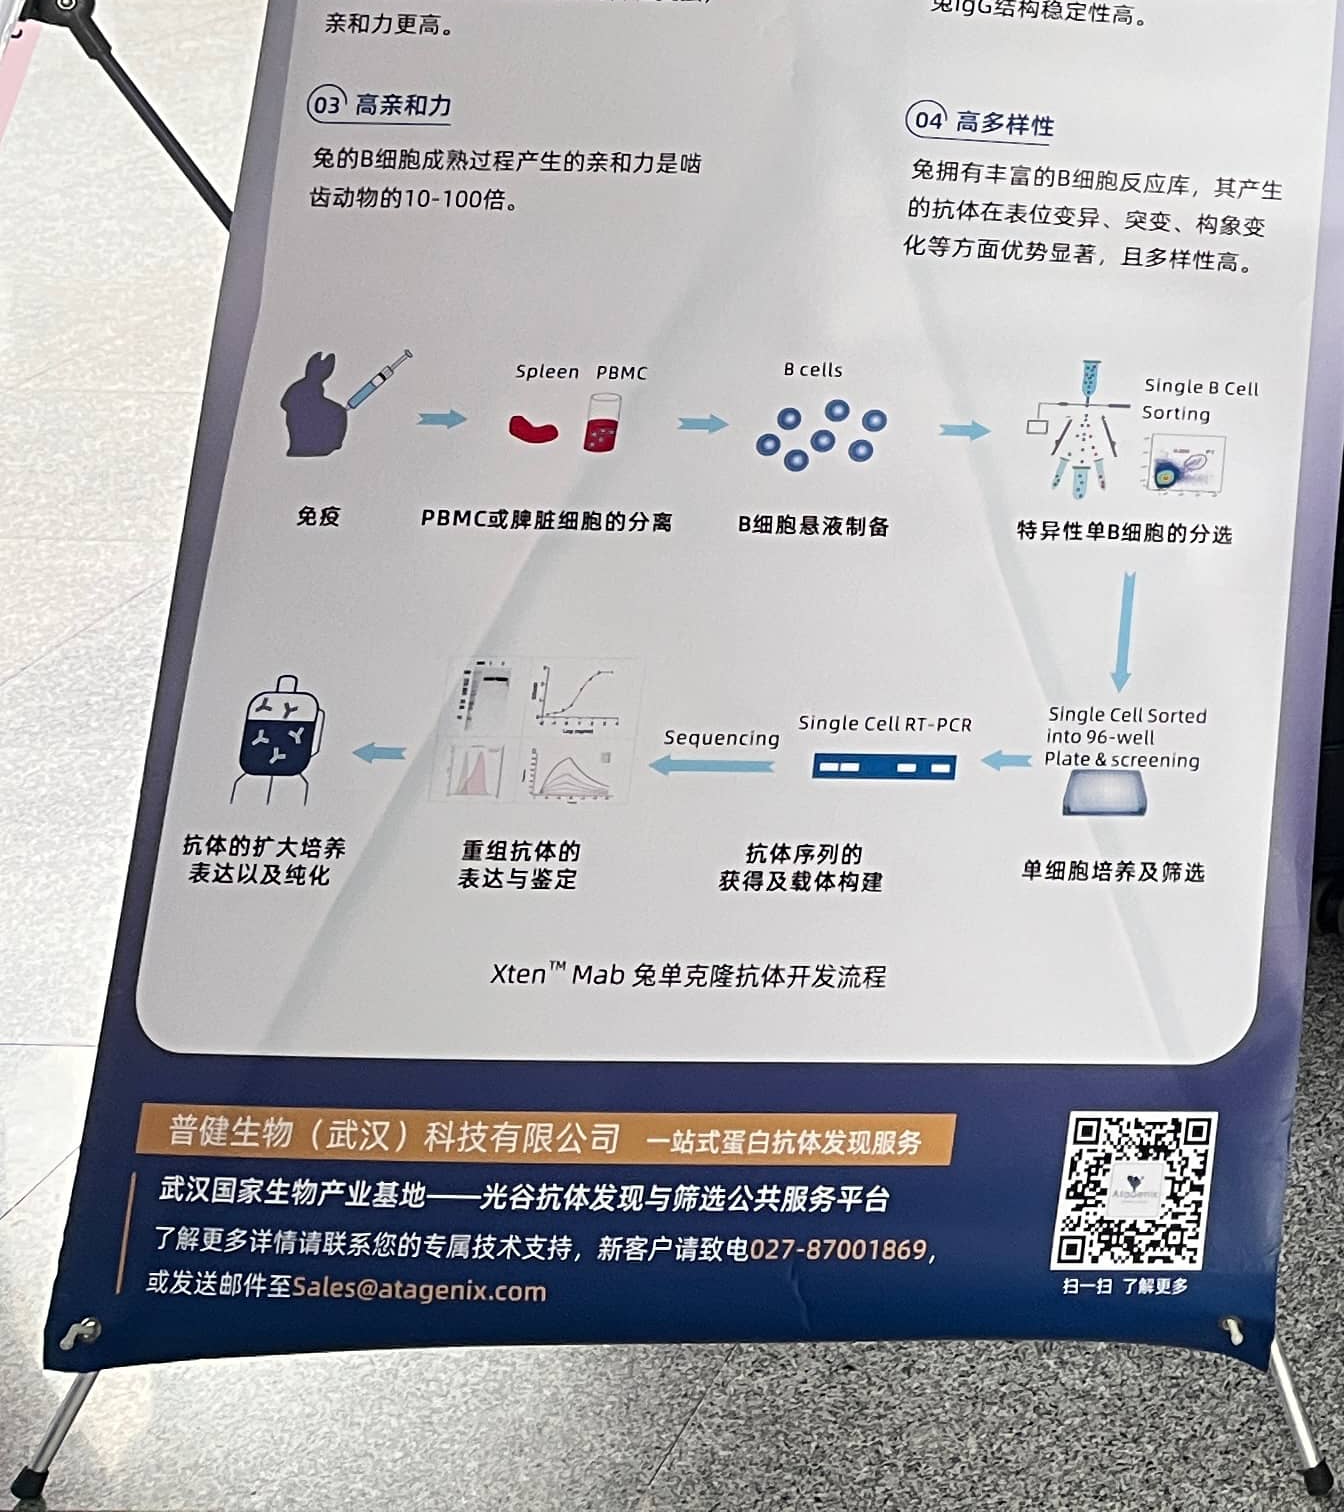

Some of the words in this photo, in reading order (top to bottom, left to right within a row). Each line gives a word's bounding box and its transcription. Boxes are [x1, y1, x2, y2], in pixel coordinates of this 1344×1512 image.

[325, 11, 452, 37] 亲和力更高。
[314, 95, 340, 115] 03
[355, 93, 452, 118] 高亲和力
[914, 111, 943, 130] 04
[956, 110, 1055, 138] 高多样性
[312, 145, 702, 176] 兔的B细胞成熟过程产生的亲和力是啮
[309, 186, 518, 213] 齿动物的10-100倍。
[515, 362, 580, 381] Spleen
[596, 364, 649, 381] PBMC
[783, 362, 796, 378] B
[798, 361, 843, 379] cells
[1144, 377, 1203, 399] Single
[1208, 381, 1220, 396] B
[1224, 380, 1260, 398] Cell
[1142, 404, 1212, 426] Sorting
[297, 505, 341, 529] 免疫
[421, 508, 673, 534] PBMC或脾脏细胞的分离
[738, 513, 890, 539] B细胞悬液制备
[1016, 519, 1234, 547] 特异性单B细胞的分选
[798, 713, 860, 735] Single
[864, 714, 901, 733] Cell
[904, 716, 973, 734] RT-PCR
[1048, 706, 1105, 728] Single
[1110, 706, 1144, 725] Cell
[1148, 706, 1208, 726] Sorted
[664, 728, 781, 749] Sequencing
[1046, 728, 1082, 745] into
[1086, 728, 1156, 746] 96-well
[1045, 750, 1090, 768] Plate
[1094, 752, 1107, 768] &
[1110, 752, 1201, 772] screening
[183, 834, 347, 860] 抗体的扩大培养
[461, 839, 581, 864] 重组抗体的
[745, 842, 864, 867] 抗体序列的
[188, 861, 331, 888] 表达以及纯化
[458, 865, 577, 891] 表达与鉴定
[718, 869, 884, 894] 获得及载体构建
[1020, 859, 1207, 884] 单细胞培养及筛选
[571, 963, 625, 987] Mab
[632, 962, 887, 990] 兔单克隆抗体开发流程
[168, 1113, 621, 1156] 普健生物（武汉）科技有限公司
[646, 1128, 923, 1156] 一站式蛋白抗体发现服务
[1063, 1277, 1114, 1296] 扫一扫
[1123, 1277, 1189, 1296] 了解更多
